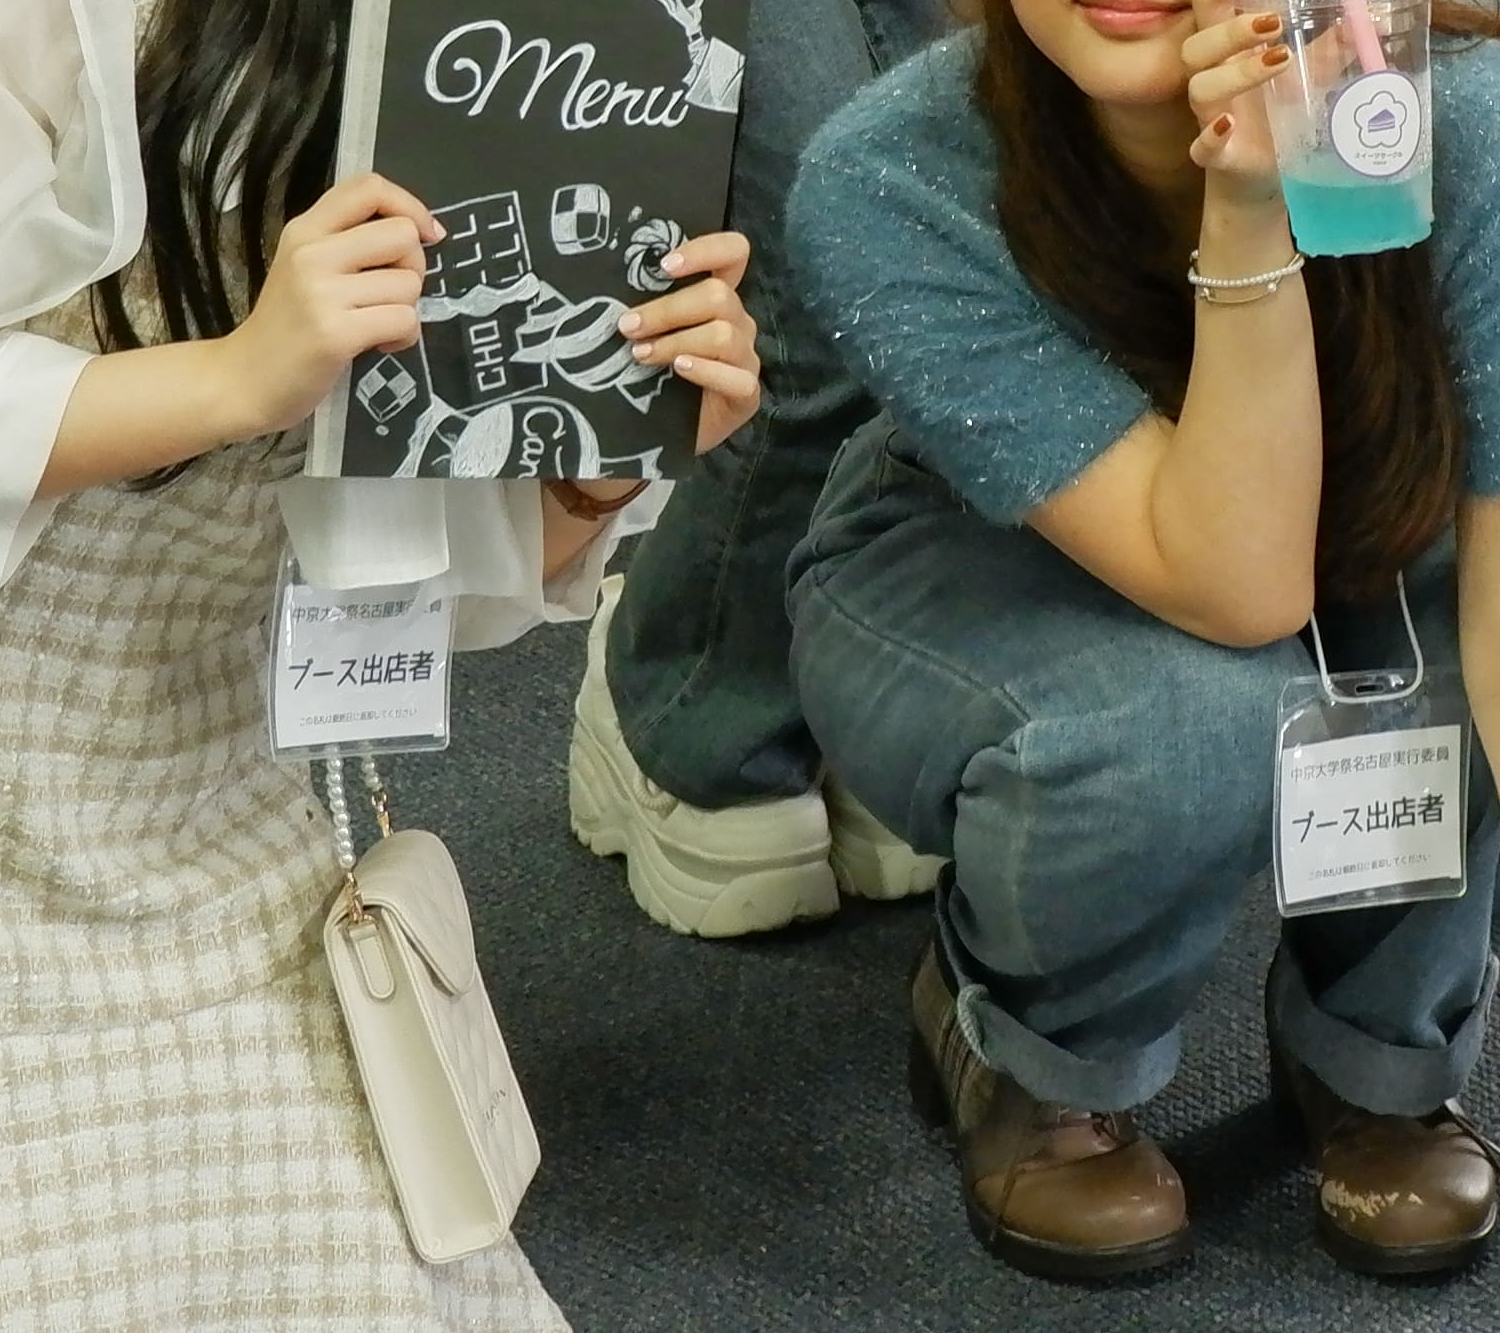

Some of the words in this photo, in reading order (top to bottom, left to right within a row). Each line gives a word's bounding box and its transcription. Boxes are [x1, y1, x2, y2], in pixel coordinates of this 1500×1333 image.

[423, 19, 689, 131] Menu
[288, 650, 435, 691] ブース出店者
[1292, 792, 1445, 843] ブース出店者
